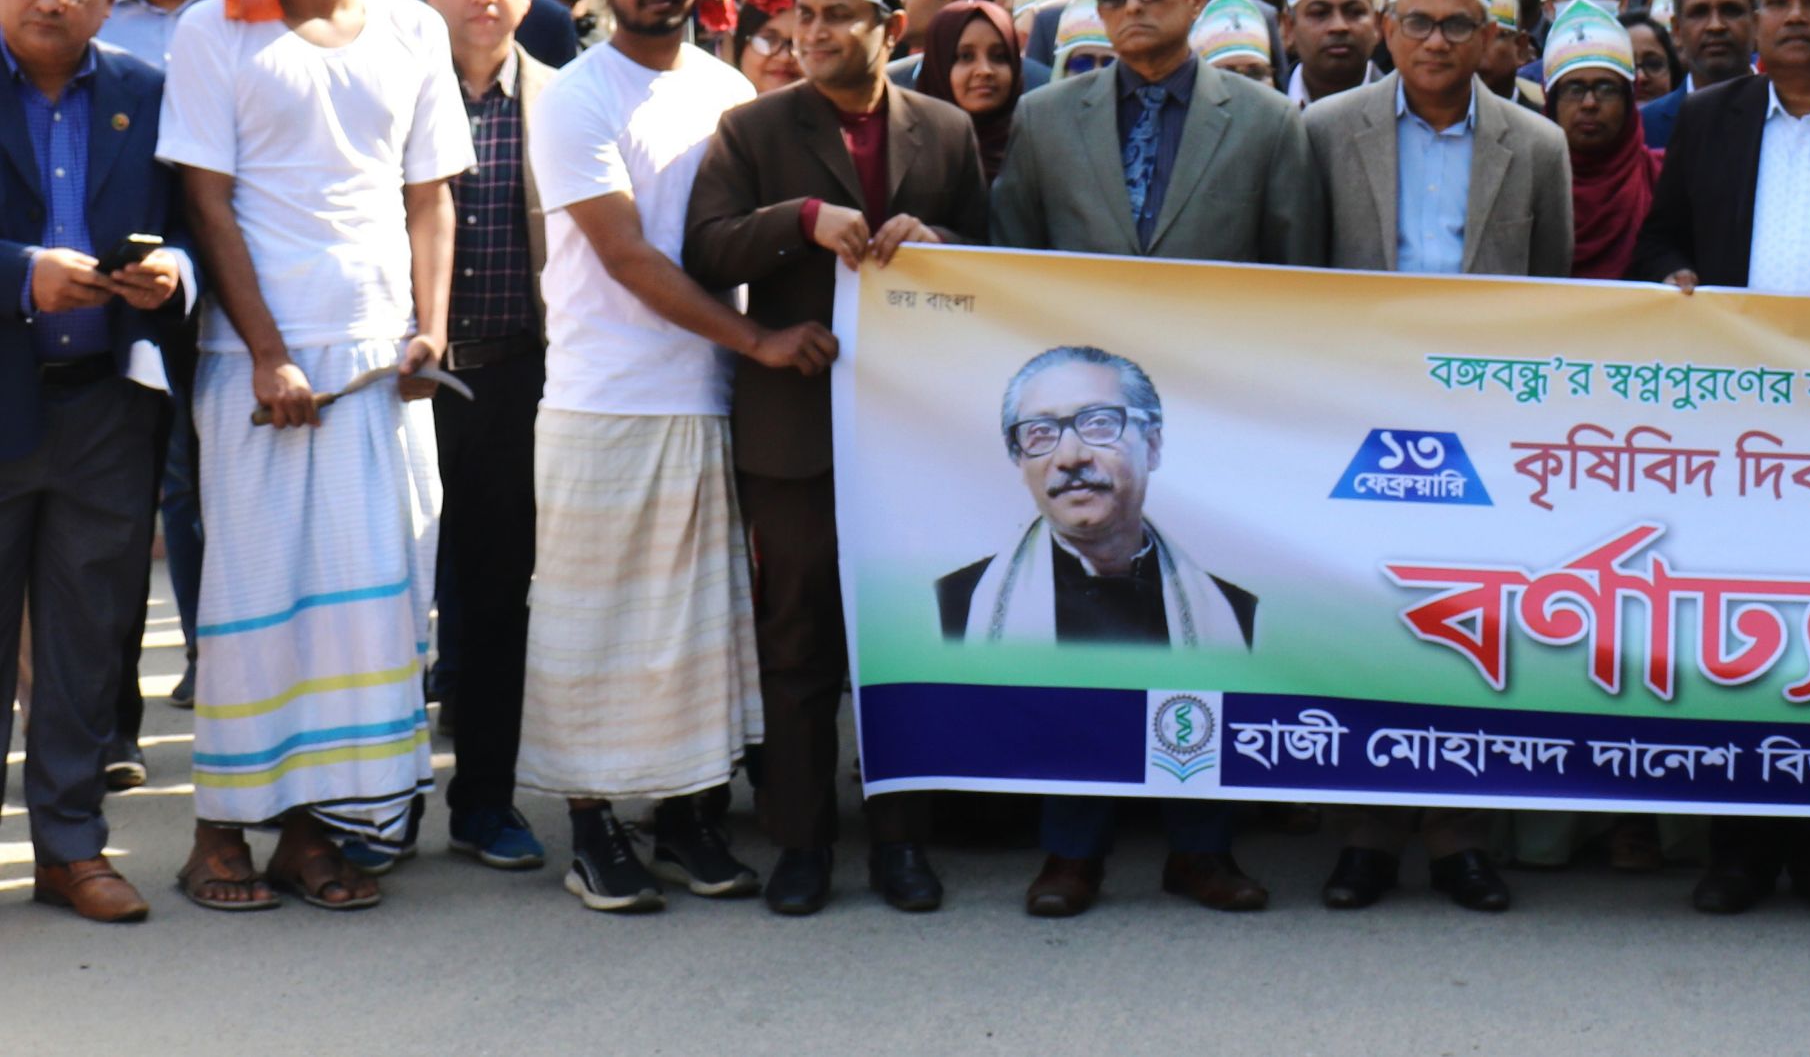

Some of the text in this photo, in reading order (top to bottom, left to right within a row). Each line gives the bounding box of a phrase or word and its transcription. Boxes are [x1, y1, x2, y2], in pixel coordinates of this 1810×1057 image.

[885, 289, 976, 313] জয় বাংলা
[1378, 430, 1446, 470] ১৩
[1510, 422, 1720, 511] কৃষিবিদ
[1229, 708, 1350, 770] হাজী
[1366, 726, 1576, 777] মোহাম্মদ
[1587, 738, 1743, 782] দানেশ
